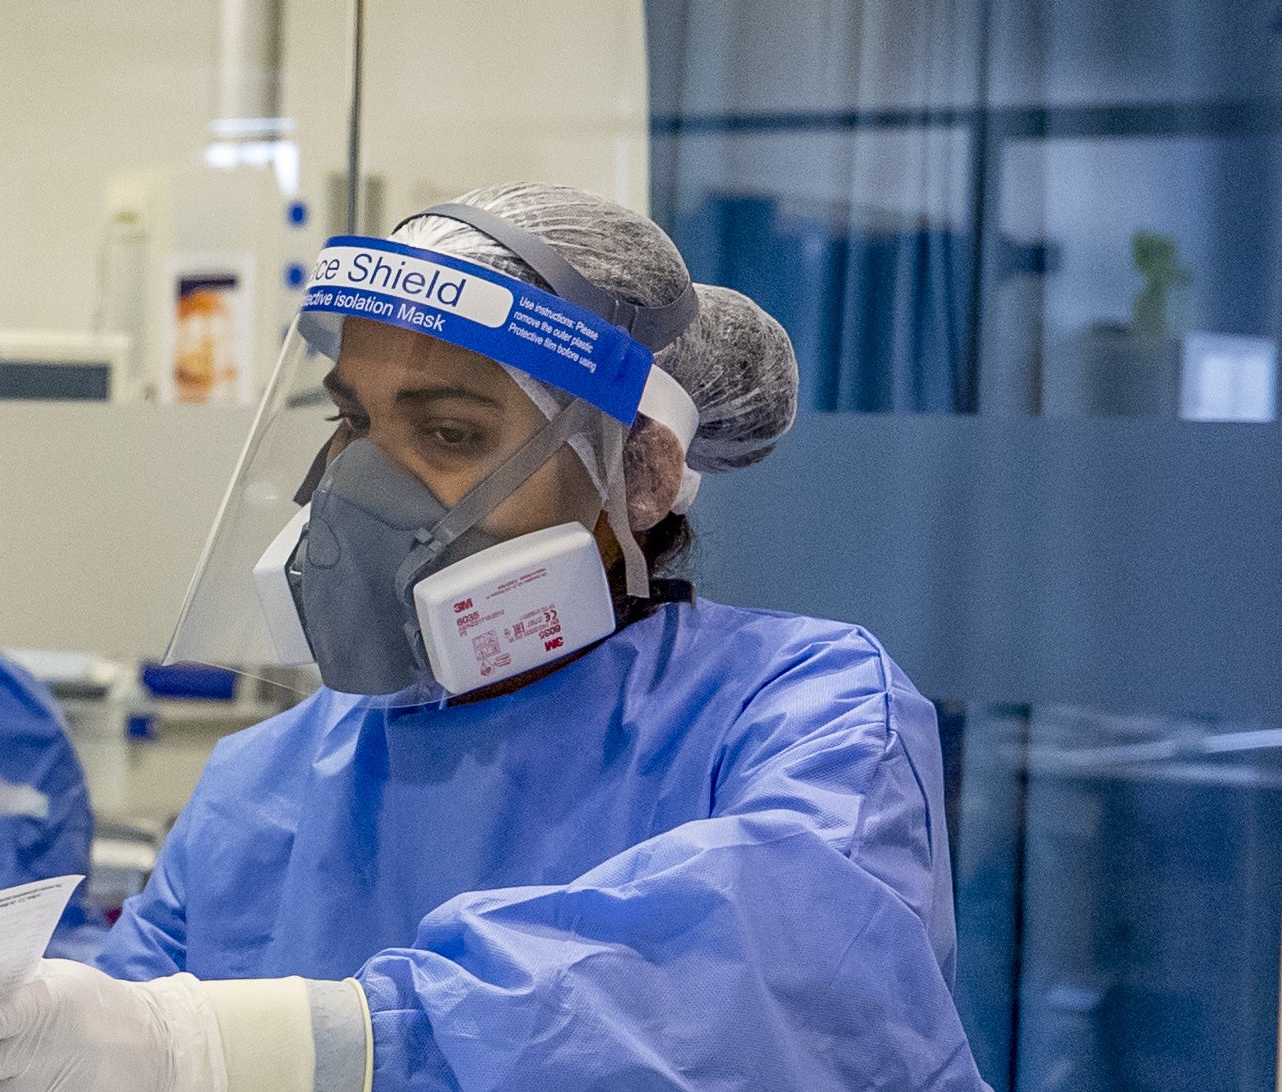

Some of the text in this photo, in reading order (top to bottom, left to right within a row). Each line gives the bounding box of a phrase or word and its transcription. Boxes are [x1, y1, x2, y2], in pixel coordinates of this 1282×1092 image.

[314, 253, 467, 308] ce Shield
[334, 290, 394, 318] isolation
[396, 303, 447, 333] Mask
[508, 321, 544, 346] Protective
[454, 598, 473, 613] 3M
[544, 636, 565, 652] 3M
